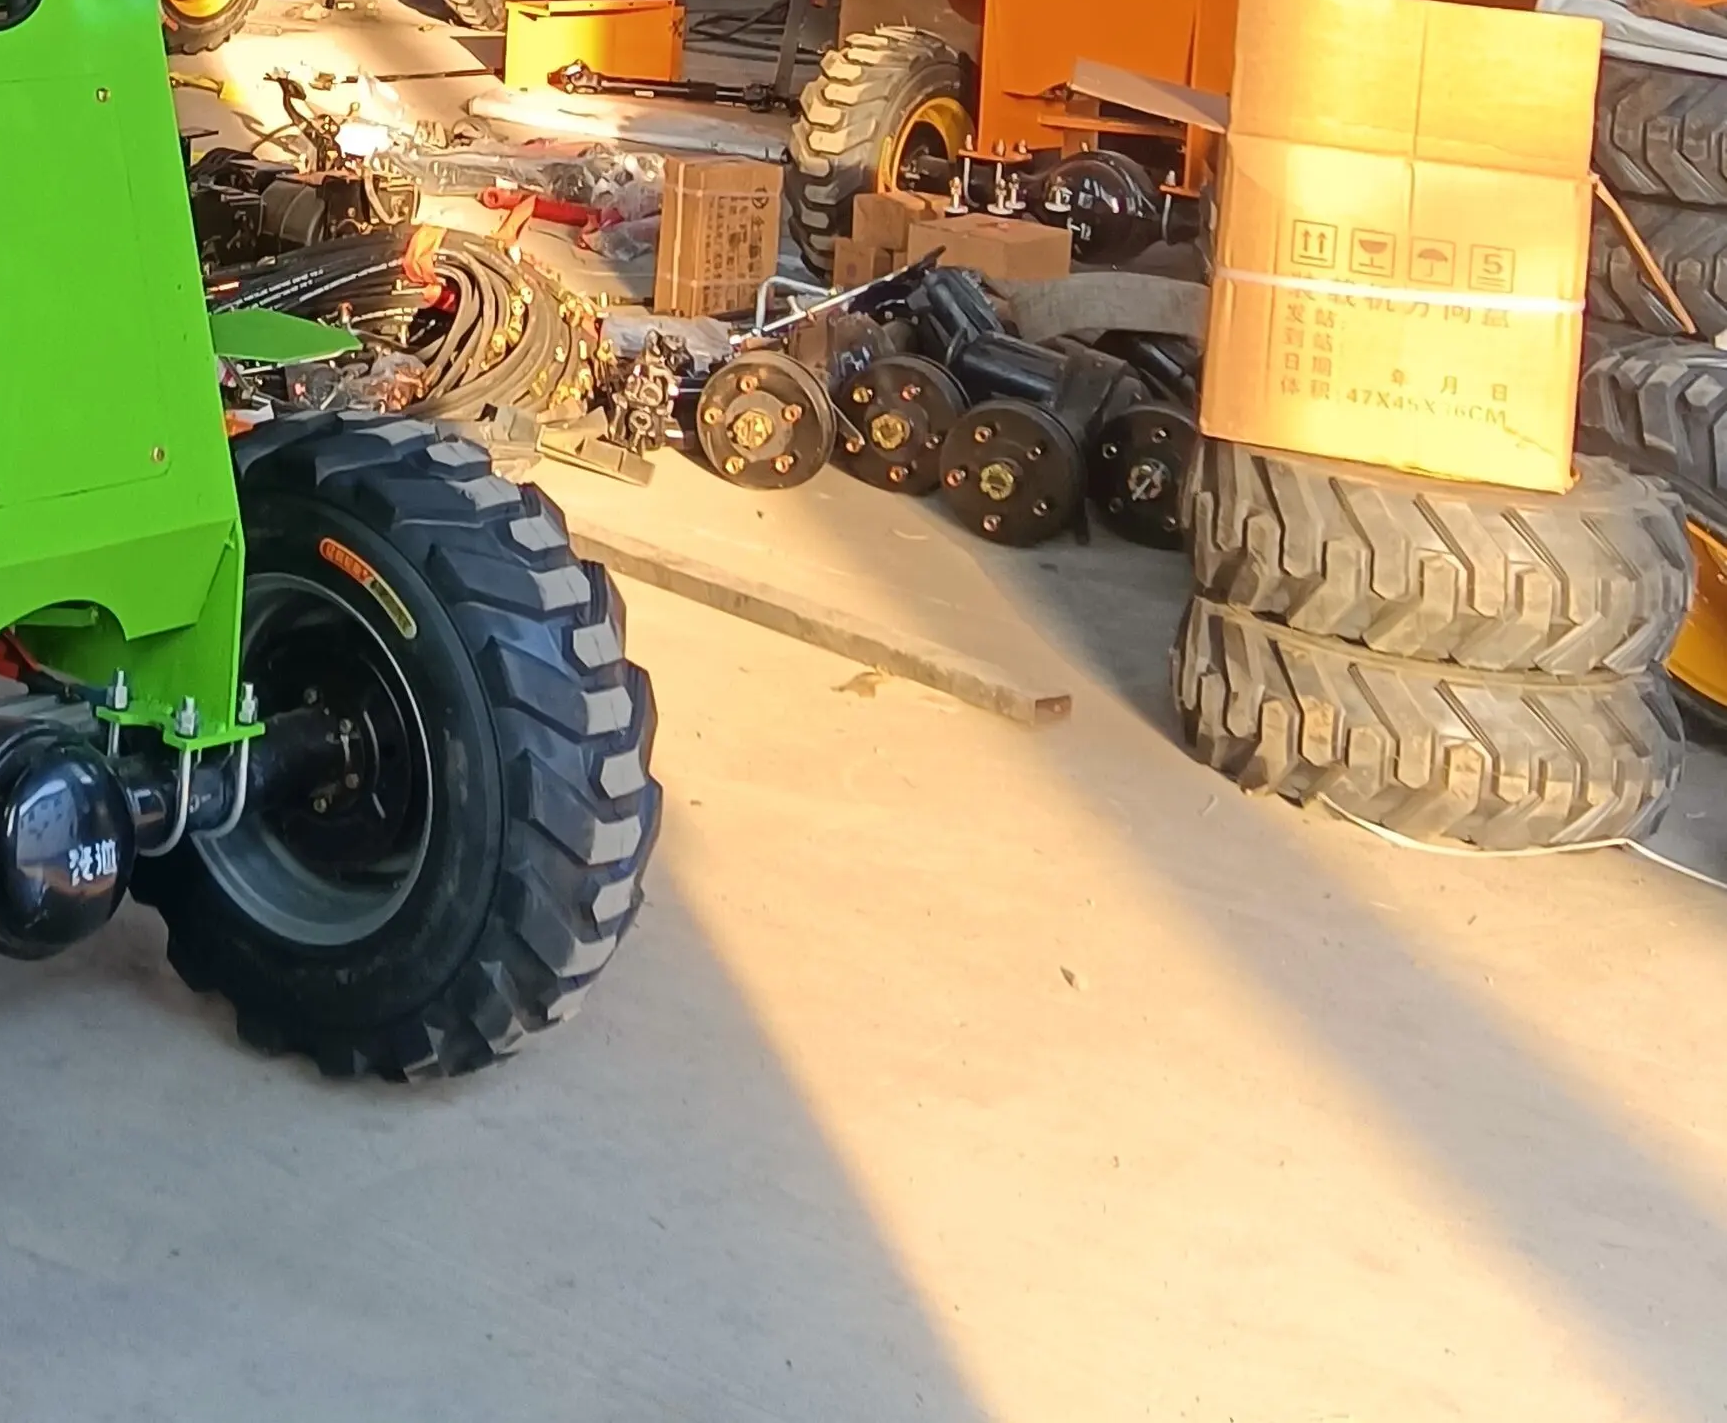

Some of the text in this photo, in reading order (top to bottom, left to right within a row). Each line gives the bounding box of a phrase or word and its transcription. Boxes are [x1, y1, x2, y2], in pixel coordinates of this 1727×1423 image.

[1482, 253, 1504, 276] 5
[1440, 375, 1458, 396] 月
[1491, 383, 1508, 402] 日
